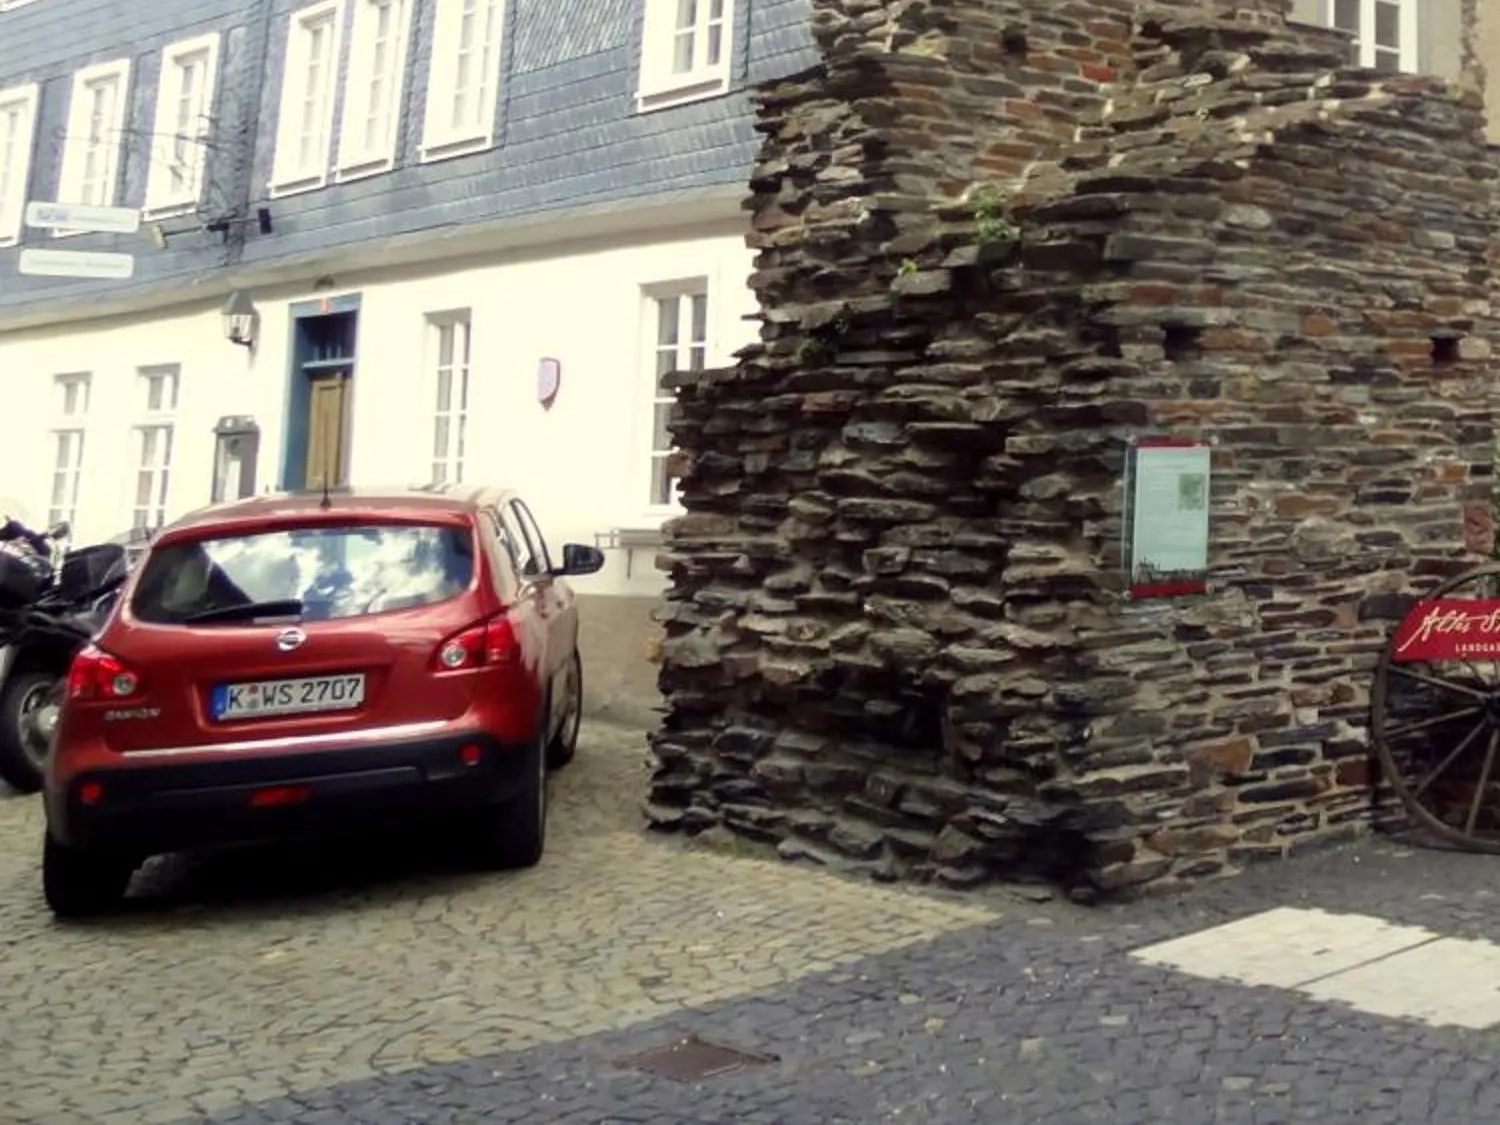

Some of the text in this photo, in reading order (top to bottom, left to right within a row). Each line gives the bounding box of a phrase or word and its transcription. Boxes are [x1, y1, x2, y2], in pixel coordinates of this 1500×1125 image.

[1411, 607, 1470, 645] Altes
[229, 677, 361, 710] K WS 2707
